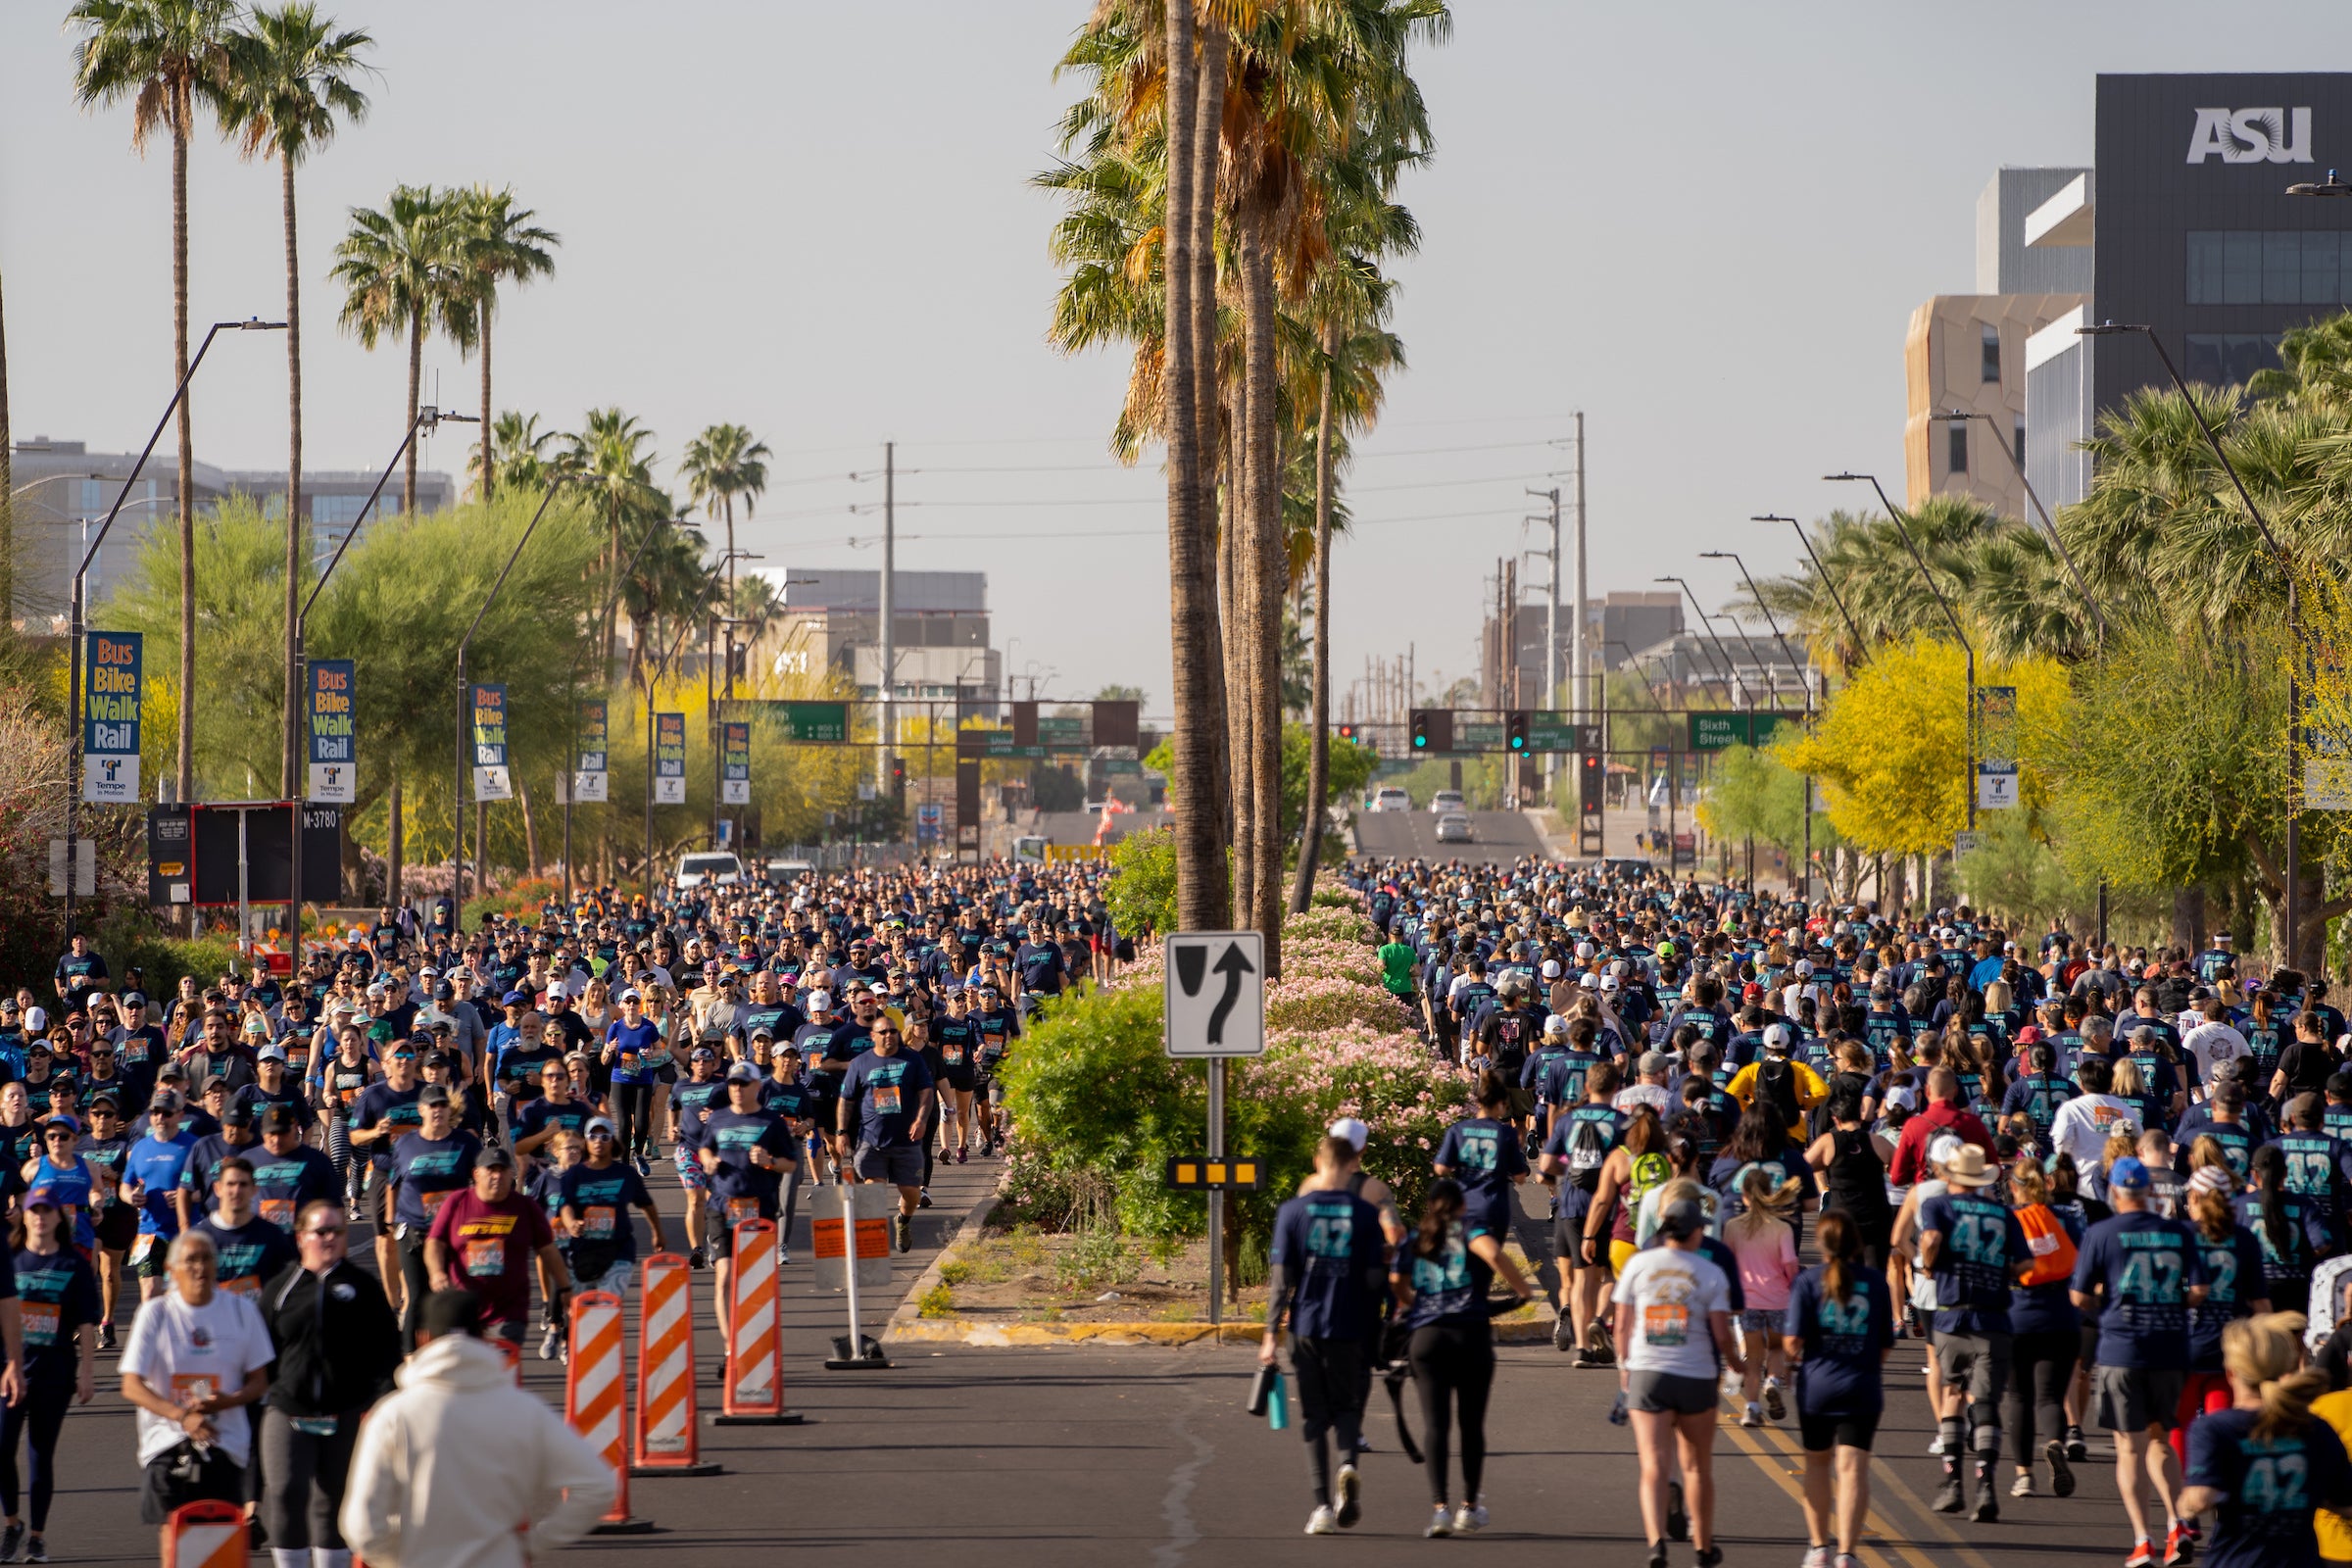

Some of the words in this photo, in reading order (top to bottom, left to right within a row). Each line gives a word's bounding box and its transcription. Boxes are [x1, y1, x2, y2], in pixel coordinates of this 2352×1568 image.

[2186, 107, 2315, 164] ASU
[98, 639, 133, 664] Bus
[93, 666, 135, 693] Bike
[318, 669, 347, 690] Bus
[316, 692, 349, 713] Bike
[476, 687, 501, 706] Bus
[89, 695, 138, 720] Walk
[474, 707, 503, 725] Bike
[313, 714, 353, 736] Walk
[662, 716, 681, 731] Bus
[728, 725, 746, 739] Bus
[1699, 719, 1731, 731] Sixth
[94, 723, 131, 749] Rail
[473, 726, 506, 744] Walk
[661, 732, 682, 746] Bike
[1699, 733, 1736, 745] Street
[318, 738, 347, 759] Rail
[477, 745, 502, 763] Rail
[659, 746, 684, 760] Walk
[727, 740, 747, 752] Bike
[582, 753, 603, 769] Rail
[726, 752, 749, 764] Walk
[662, 760, 681, 775] Rail
[728, 765, 746, 779] Rail
[96, 782, 125, 791] Tempe
[304, 810, 336, 828] M-3780
[1684, 1012, 1715, 1021] TILLMAN
[1499, 1024, 1520, 1039] 40
[2250, 1030, 2278, 1055] 42
[1458, 1138, 1497, 1169] 42
[2282, 1140, 2330, 1152] TILLMAN
[2284, 1152, 2331, 1195] 42
[1951, 1200, 2006, 1218] TILLMAN
[458, 1224, 489, 1236] PAT'S
[489, 1223, 514, 1234] RUN
[1306, 1217, 1352, 1257] 42
[1949, 1214, 2006, 1267] 42
[2119, 1232, 2182, 1248] TILLMAN
[2119, 1250, 2182, 1303] 42
[1819, 1295, 1870, 1335] 42
[2242, 1454, 2308, 1513] 42
